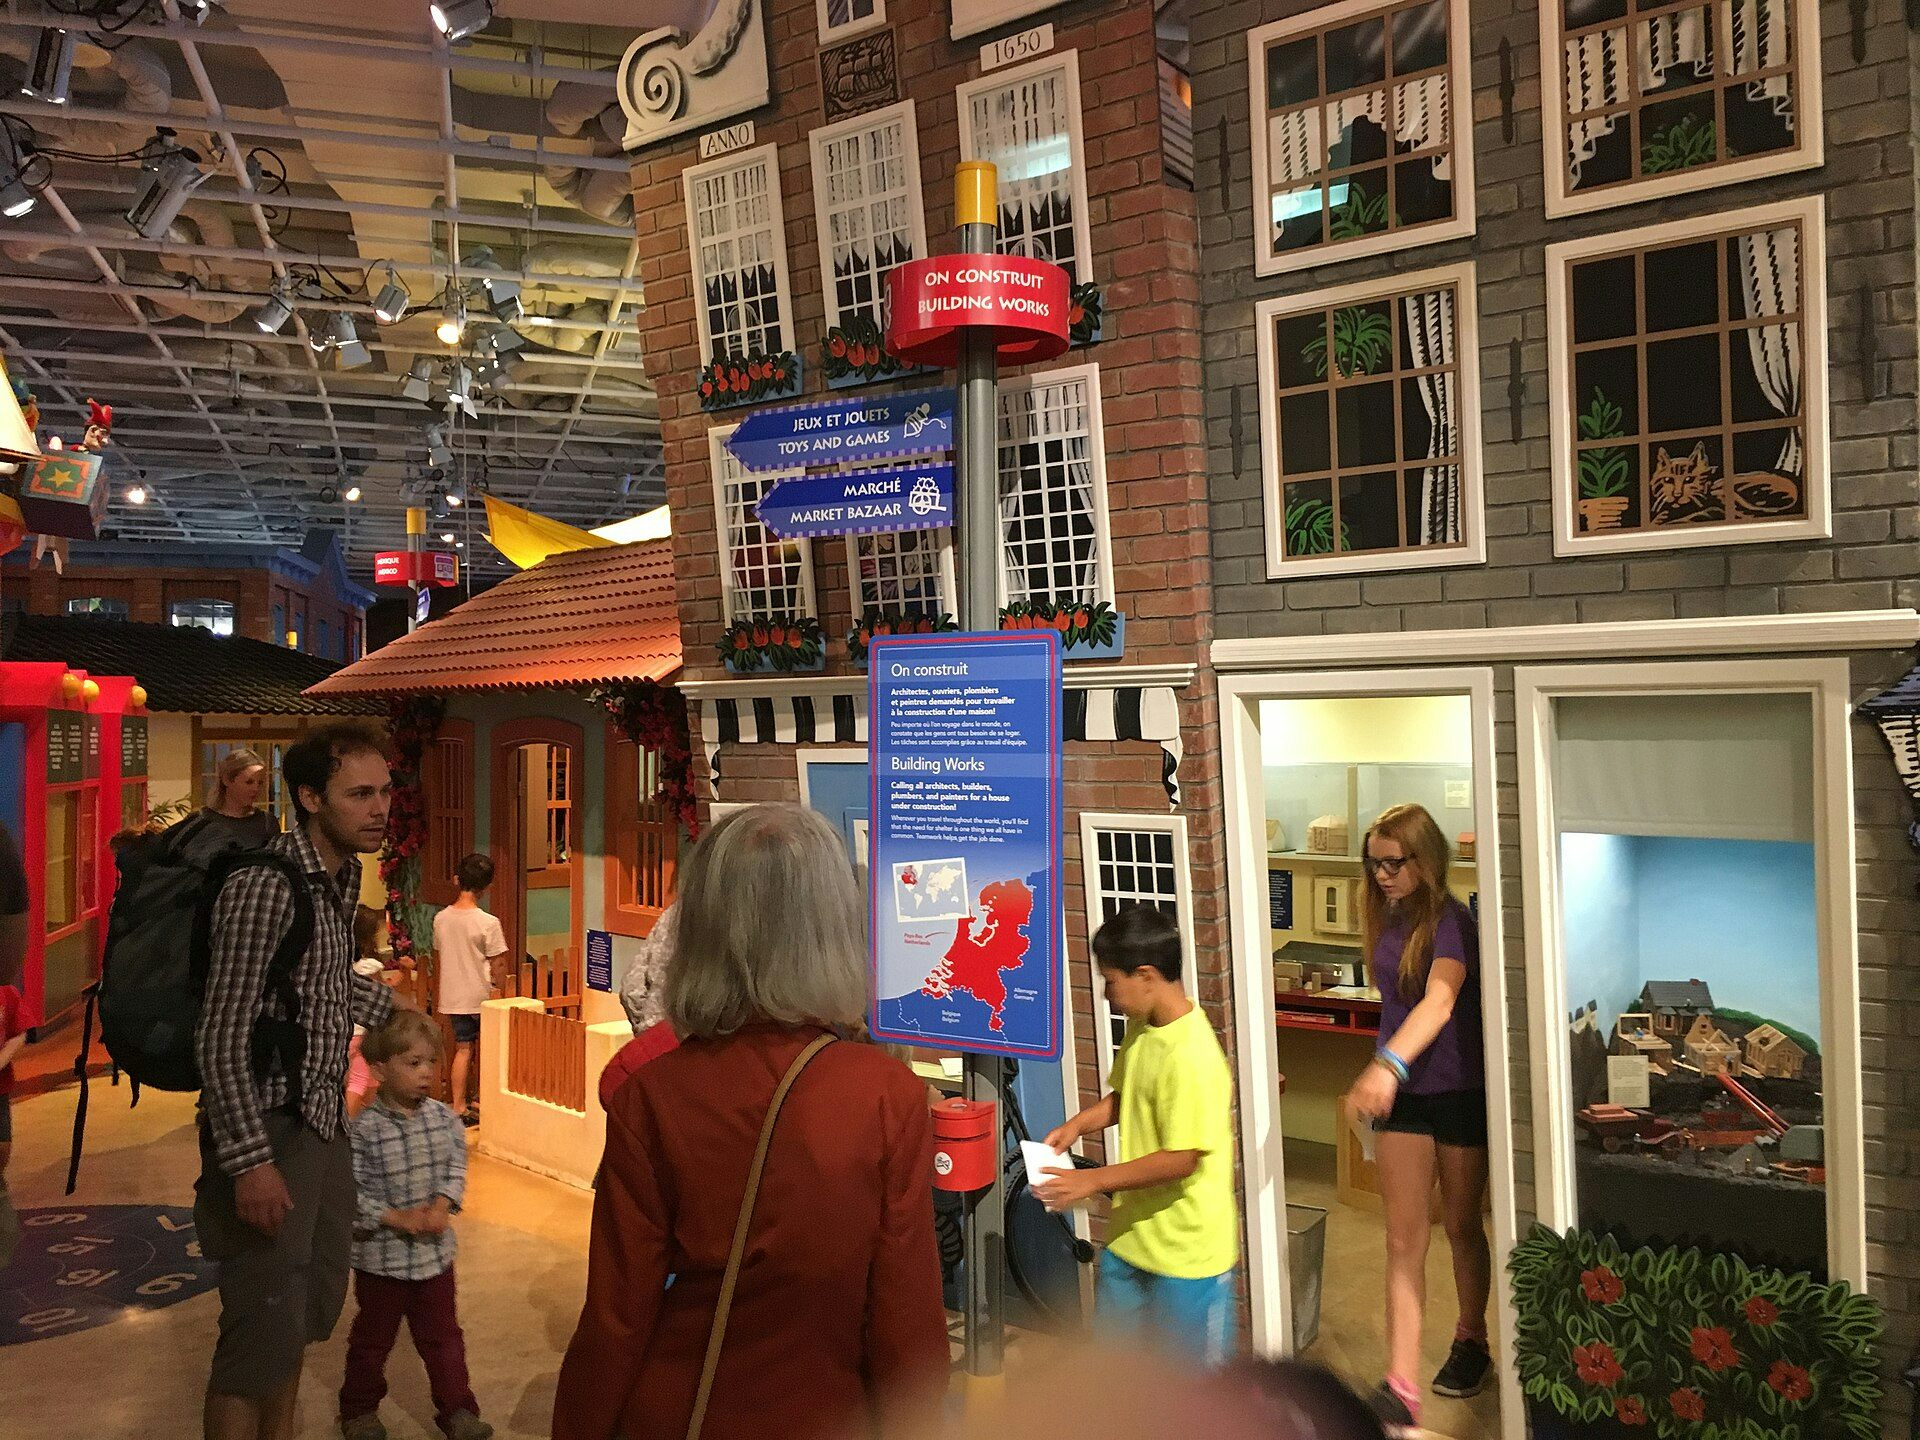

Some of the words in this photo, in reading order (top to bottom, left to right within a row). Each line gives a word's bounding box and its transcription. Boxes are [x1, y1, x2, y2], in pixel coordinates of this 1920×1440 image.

[994, 30, 1041, 63] 1650
[706, 124, 749, 155] ANNO
[925, 271, 949, 286] ON
[955, 269, 1044, 289] CONSTRUIT
[918, 295, 992, 314] BUILDING
[998, 296, 1050, 317] WORKS
[793, 416, 822, 432] JEUX
[826, 413, 841, 427] ET
[845, 407, 890, 426] JOUETS
[778, 440, 809, 455] TOYS
[813, 436, 842, 451] AND
[845, 430, 890, 447] GAMES
[844, 477, 901, 497] MARCHÉ
[790, 508, 843, 523] MARKET
[847, 503, 902, 519] BAZAAR
[891, 663, 910, 677] On
[914, 662, 969, 676] construit
[891, 688, 931, 696] Architectes,
[932, 687, 962, 695] ouvriers,
[964, 686, 999, 696] plombiers
[900, 698, 927, 707] peintres
[984, 697, 1015, 705] travailler
[931, 739, 960, 747] accomplies
[892, 757, 941, 774] Building
[944, 757, 985, 771] Works
[891, 782, 914, 791] Calling
[925, 782, 960, 791] architects,
[962, 783, 992, 791] builders,
[891, 792, 924, 800] plumbers,
[940, 793, 968, 801] painters
[970, 793, 981, 801] for
[989, 794, 1010, 802] house
[912, 803, 957, 811] construction!
